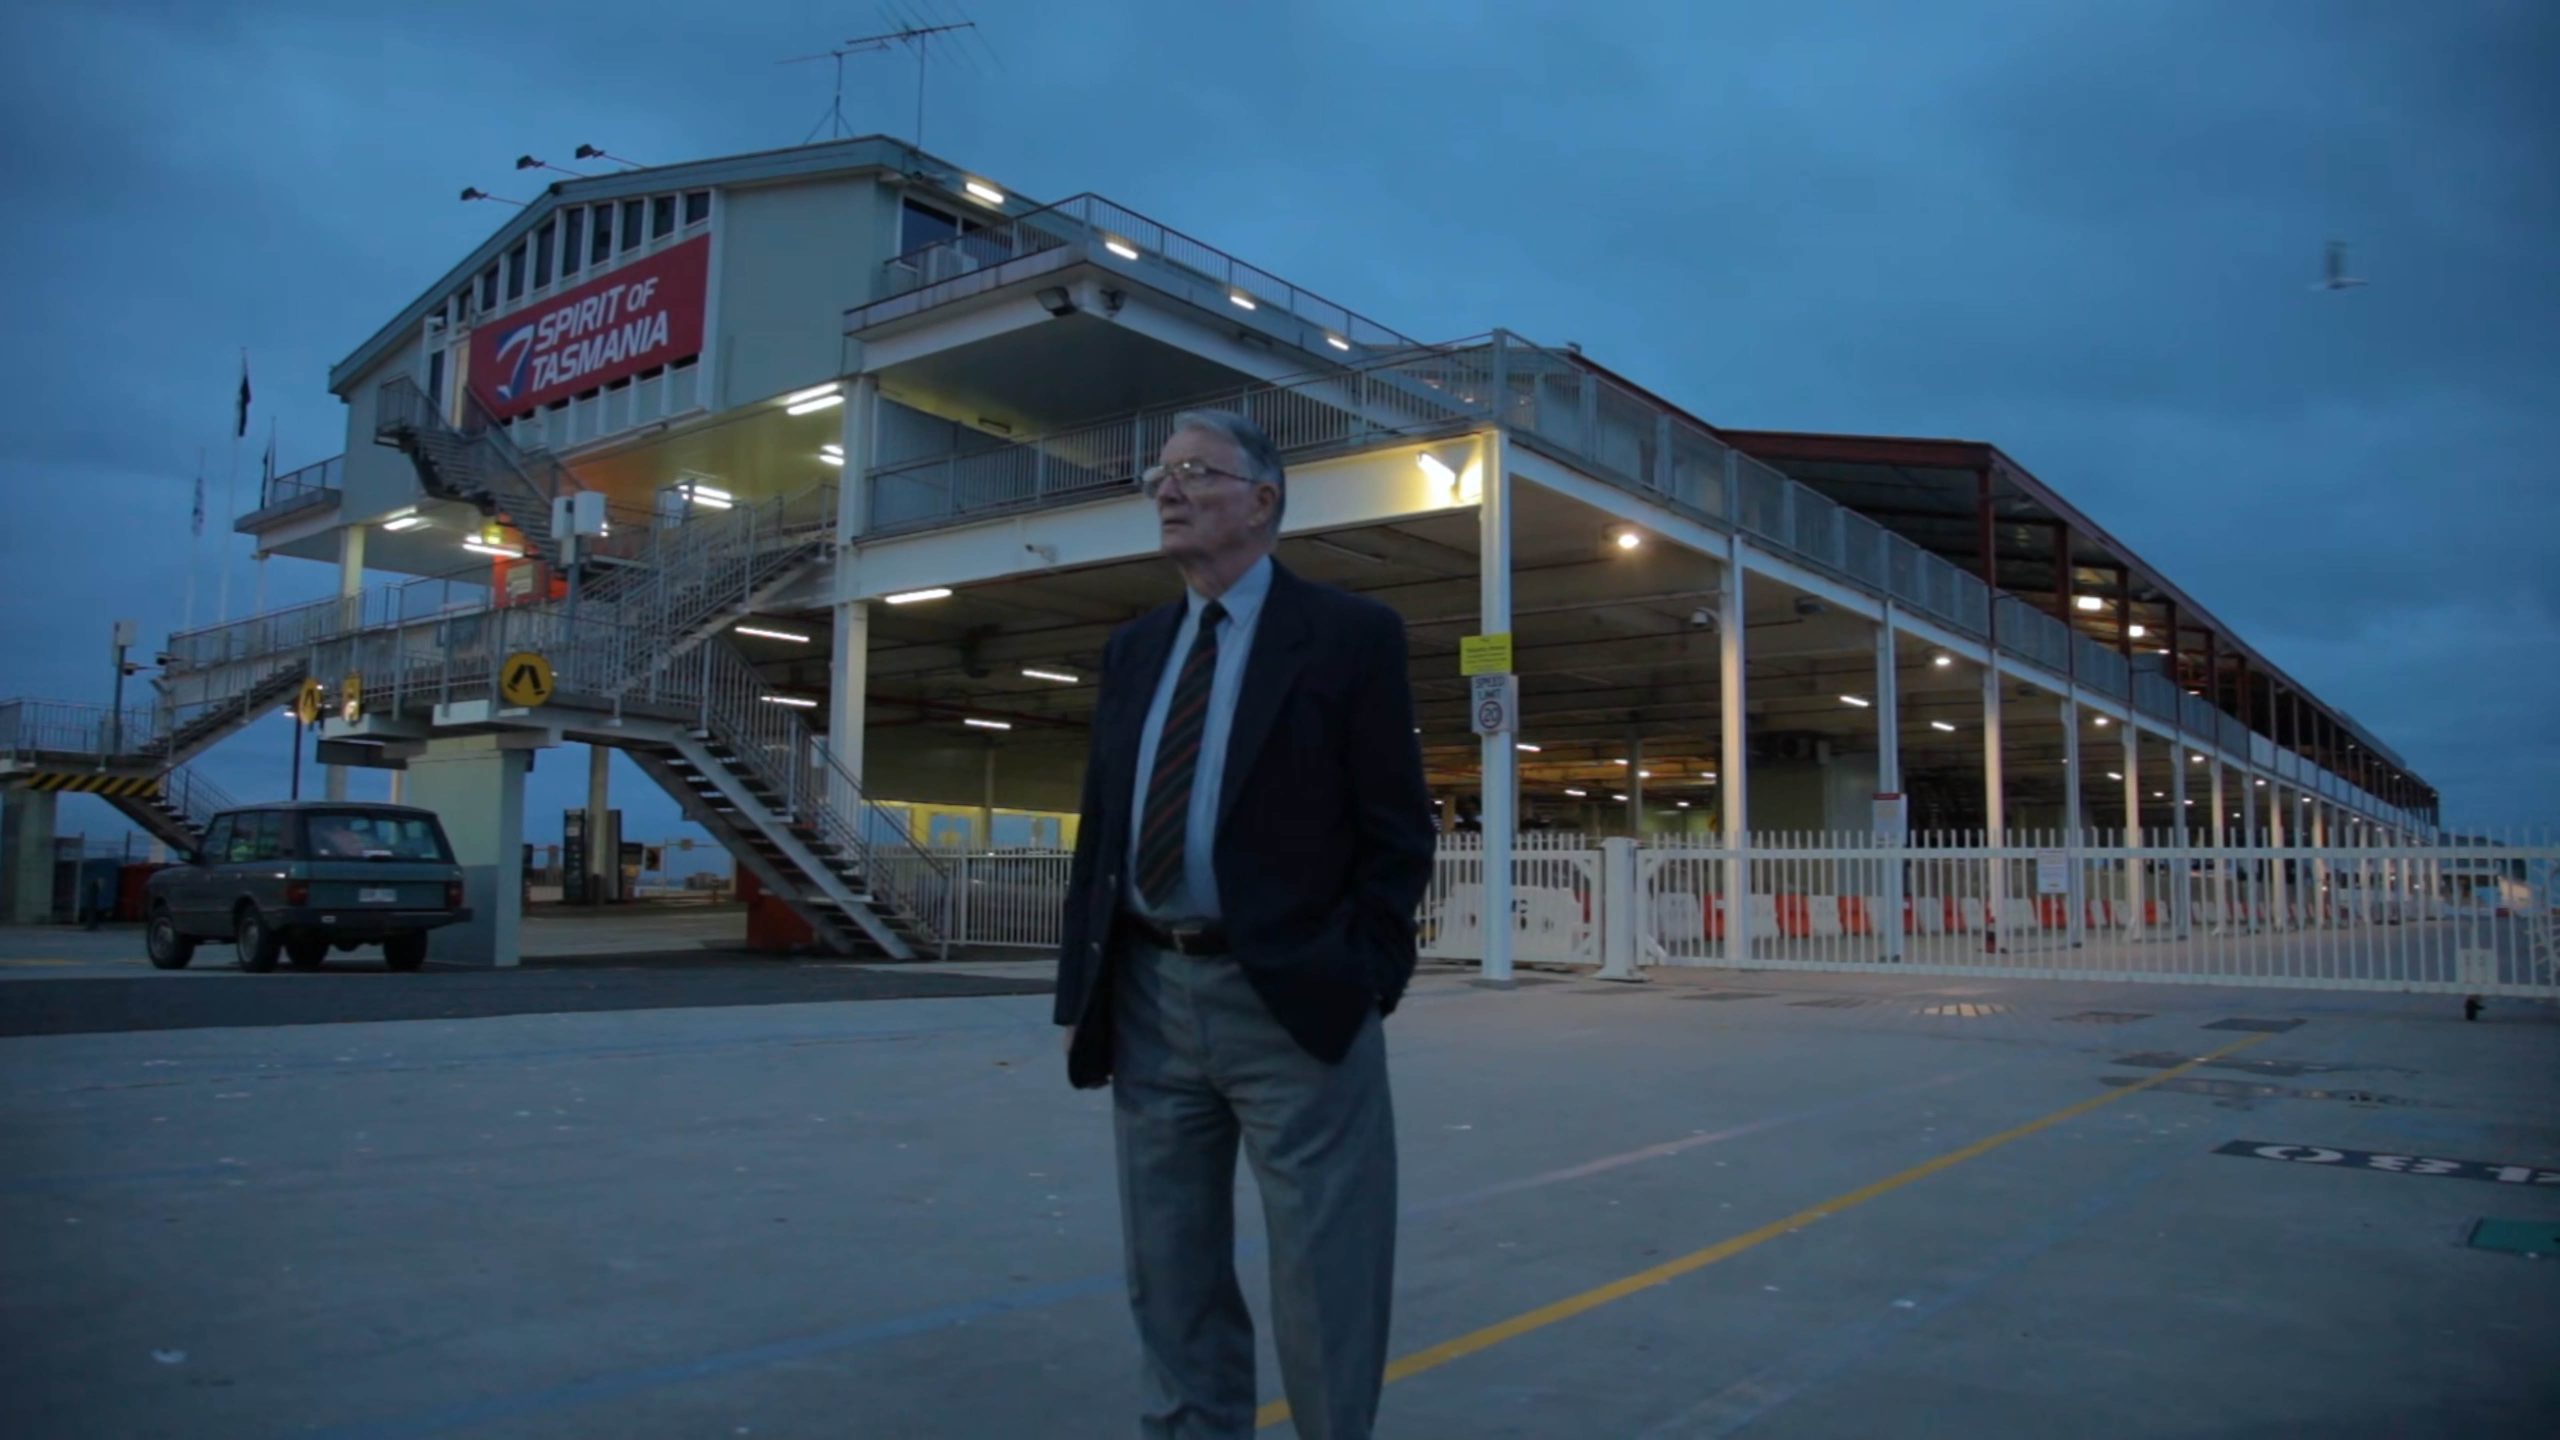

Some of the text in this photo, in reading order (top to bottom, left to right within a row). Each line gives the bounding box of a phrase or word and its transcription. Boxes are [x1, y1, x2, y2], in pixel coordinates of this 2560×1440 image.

[535, 277, 659, 352] SPIRIT OF
[531, 310, 669, 392] TASMANIA
[1475, 676, 1505, 689] SPEED
[1478, 688, 1502, 700] LIMIT
[1482, 706, 1499, 722] 20
